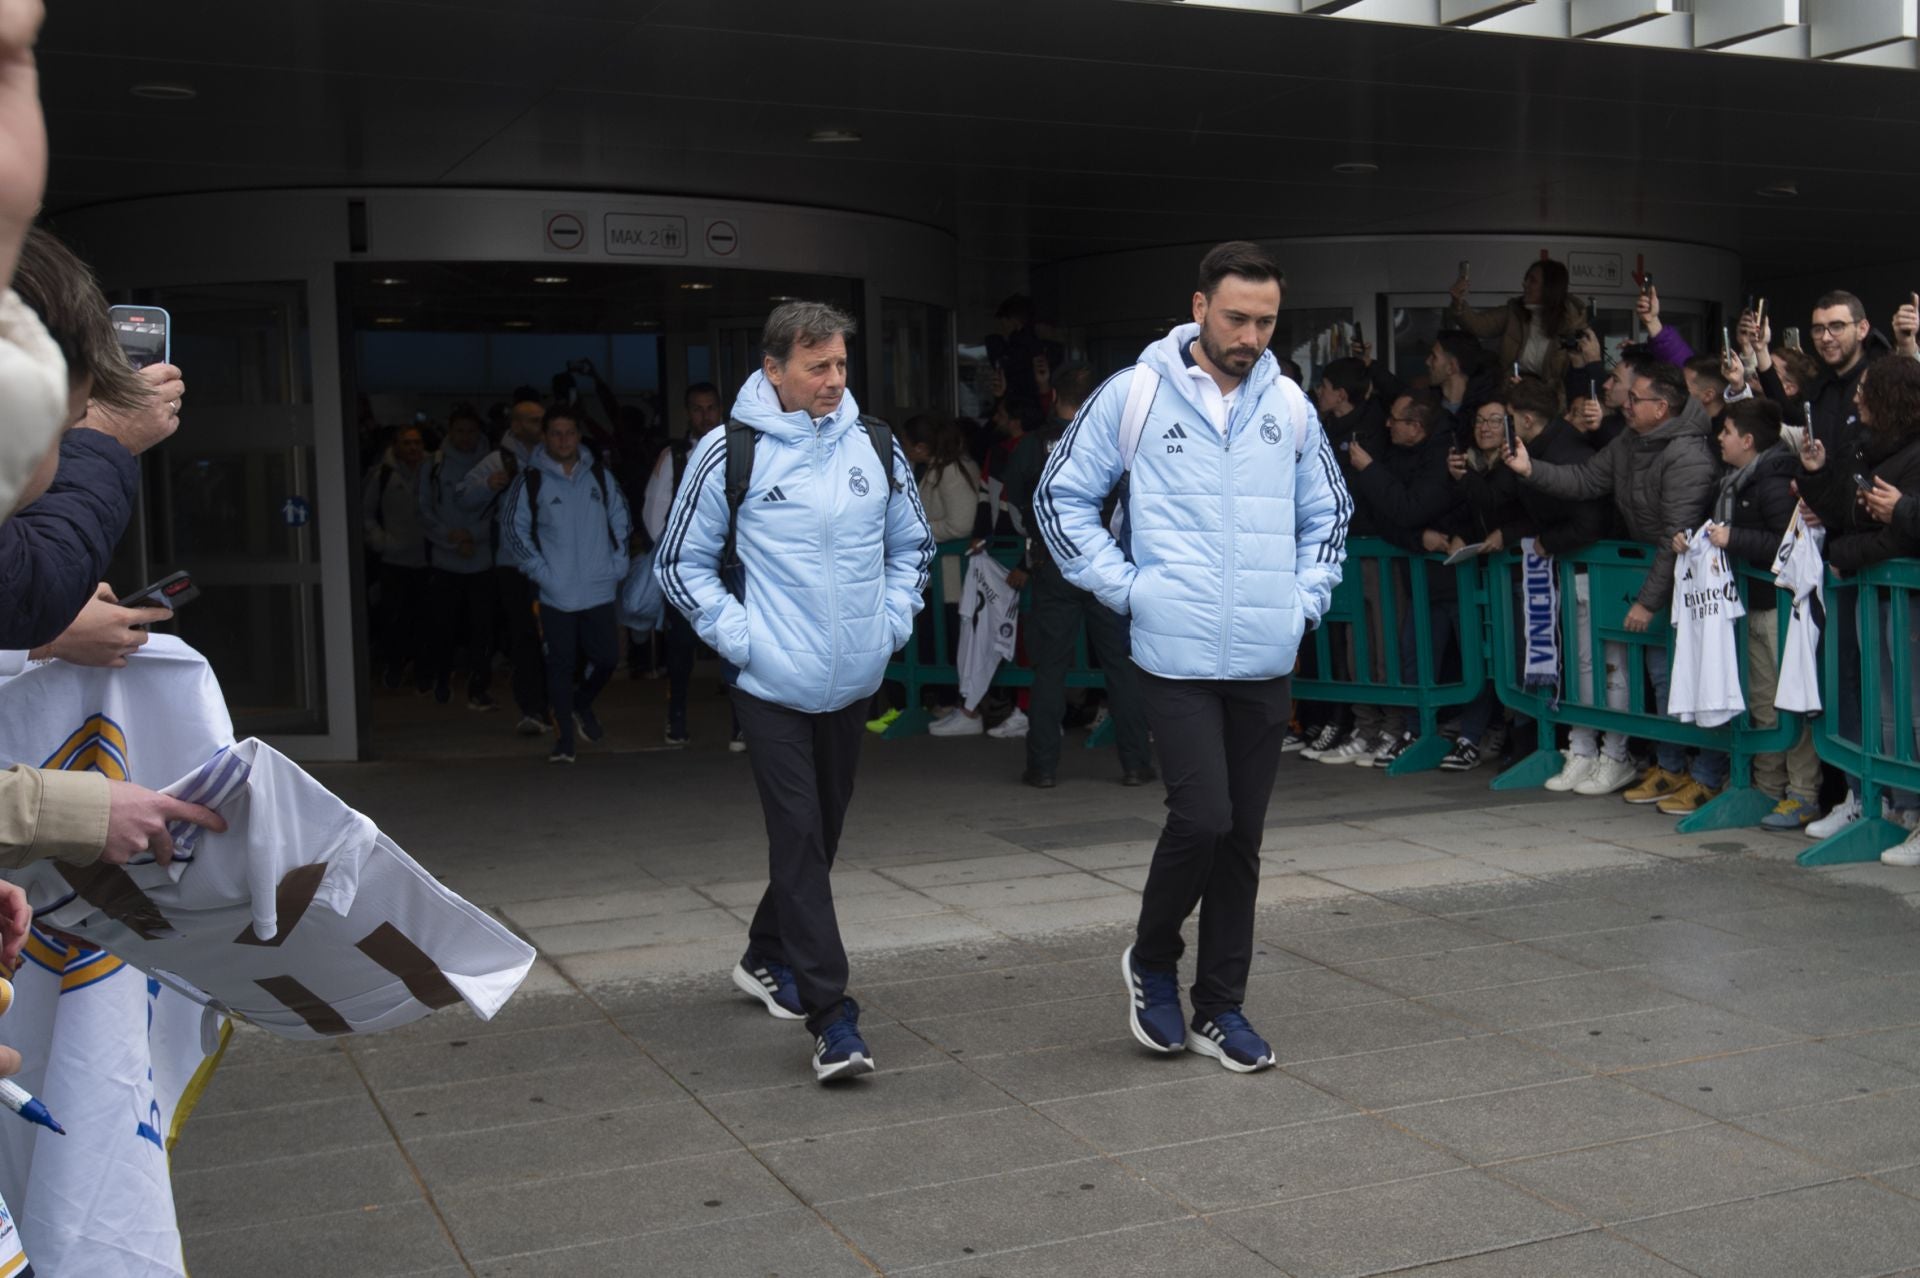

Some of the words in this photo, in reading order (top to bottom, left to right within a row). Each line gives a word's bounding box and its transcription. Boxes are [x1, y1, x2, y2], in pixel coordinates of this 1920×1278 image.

[611, 229, 647, 245] MAX.
[649, 230, 659, 246] 2
[1166, 445, 1184, 454] DA
[1527, 553, 1554, 664] VINICIUS
